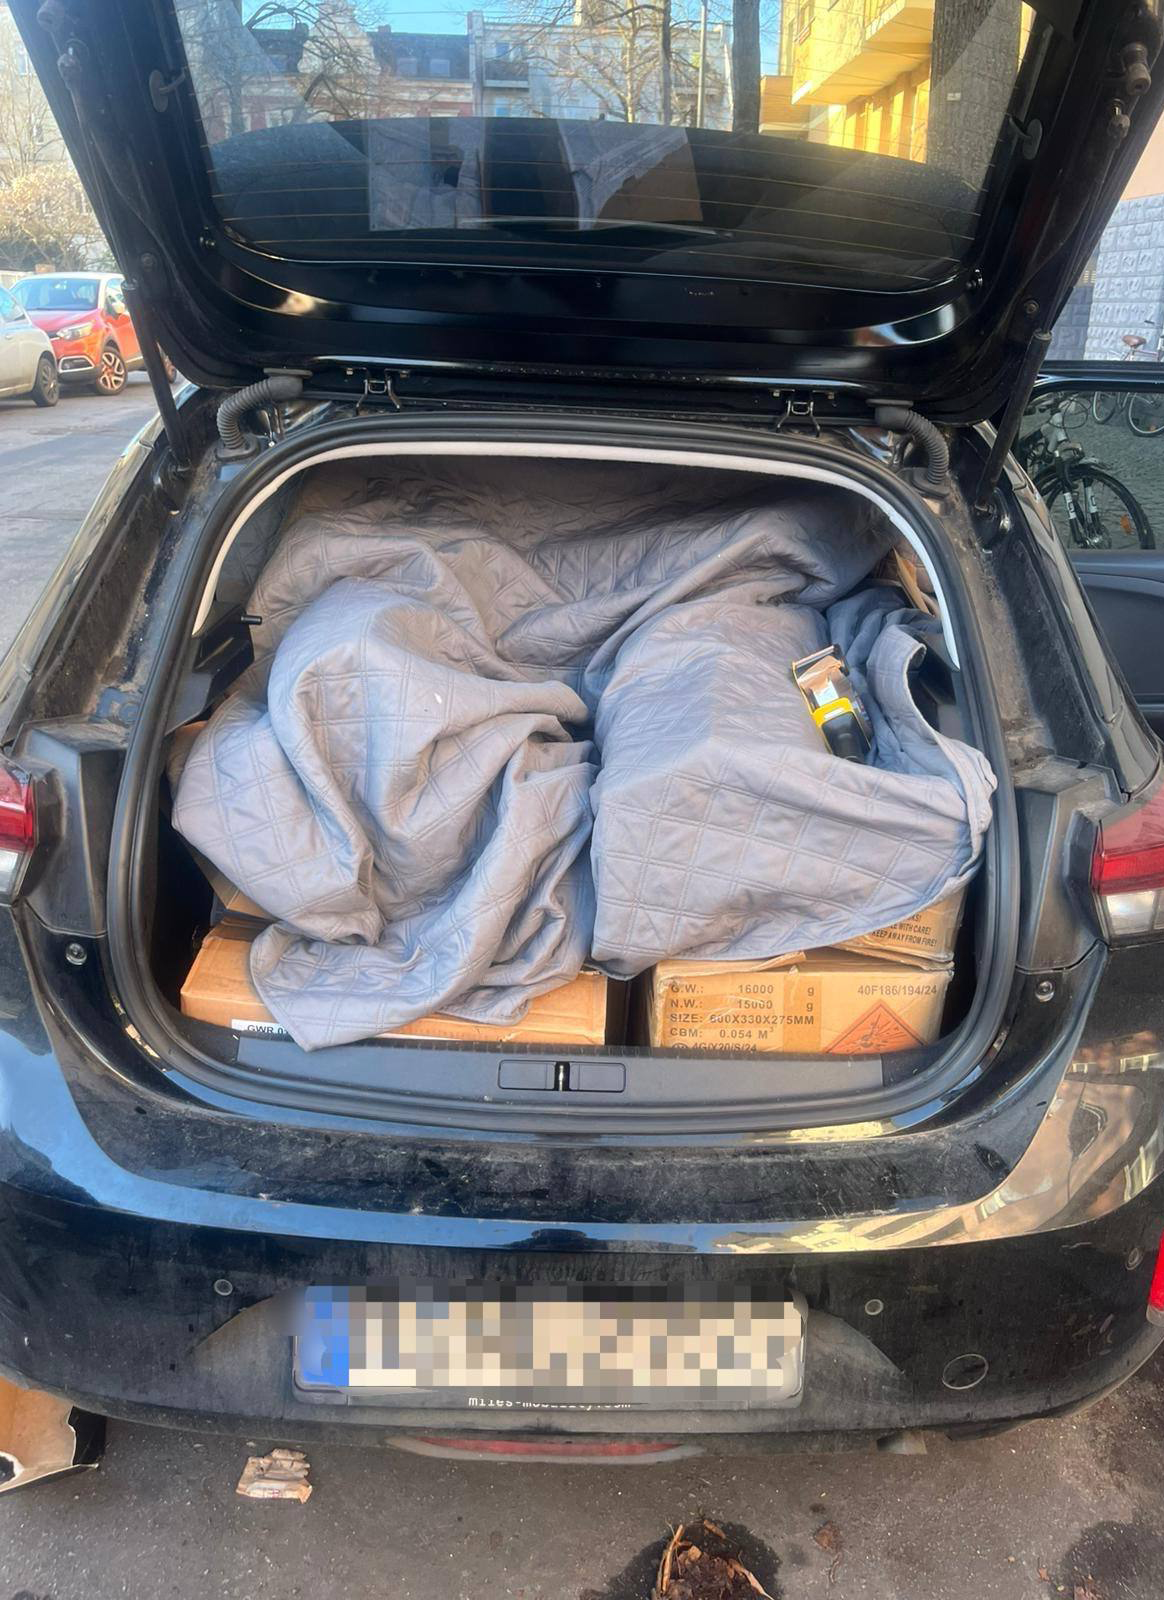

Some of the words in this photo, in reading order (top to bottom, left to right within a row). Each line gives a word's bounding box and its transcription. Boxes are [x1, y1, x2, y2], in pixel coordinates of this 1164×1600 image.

[670, 983, 704, 994] G.W.:
[738, 984, 774, 994] 16000
[857, 984, 938, 996] 40F186/194/24
[670, 999, 703, 1009] N.W.:
[737, 999, 773, 1010] 15000
[669, 1013, 703, 1023] SIZE:
[247, 1024, 274, 1034] GWR
[670, 1027, 703, 1038] CBM:
[719, 1029, 753, 1039] 0.054
